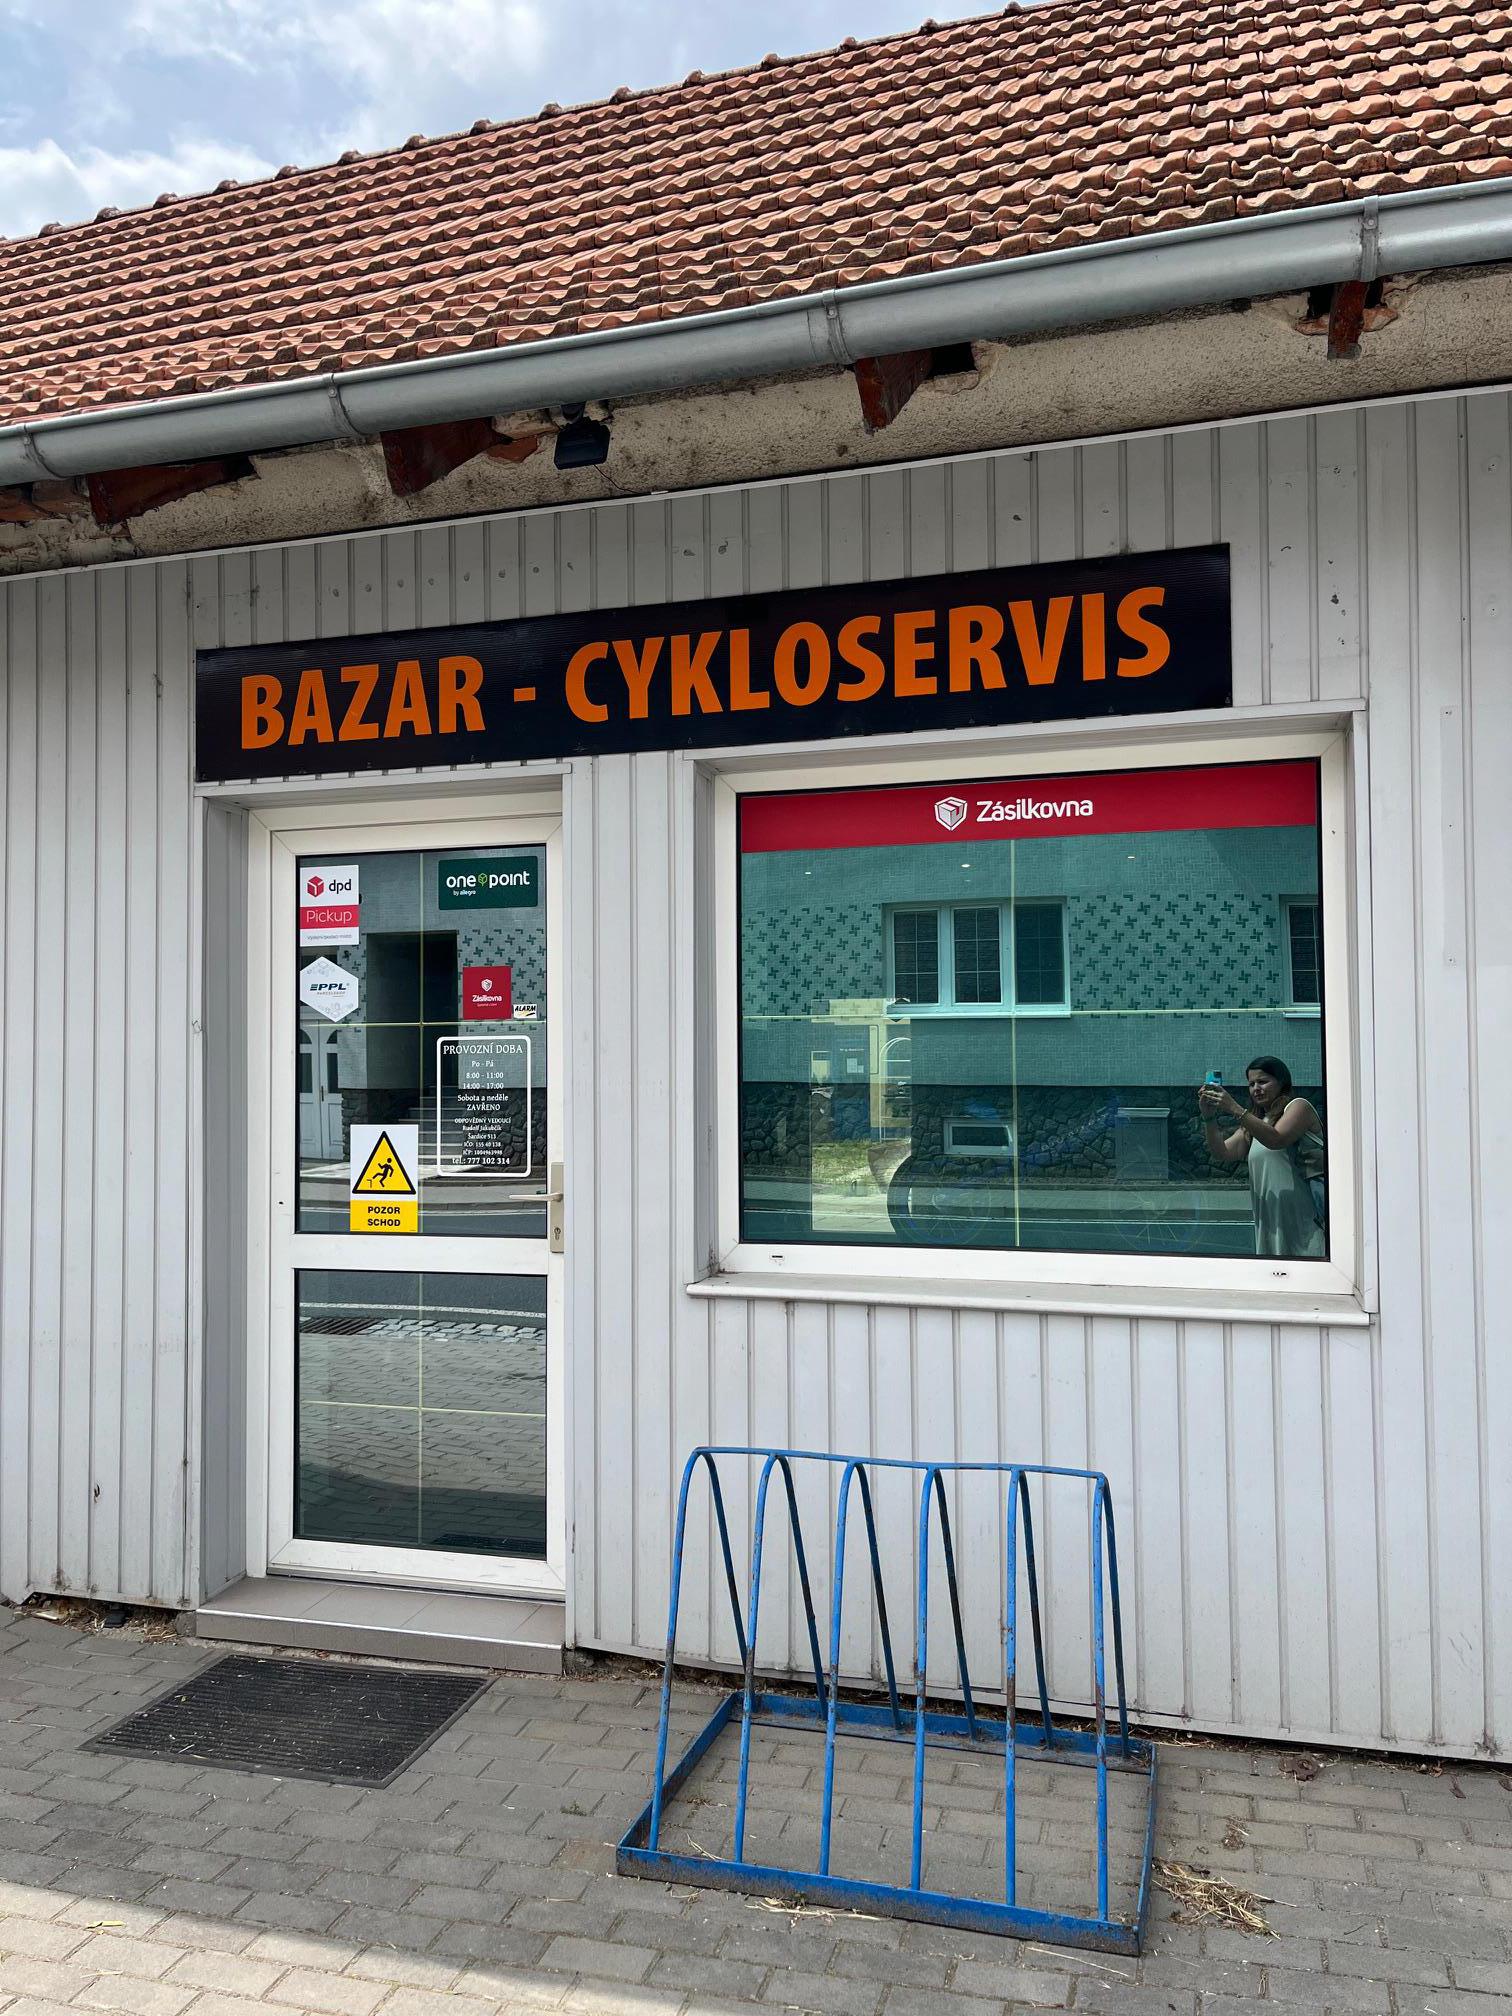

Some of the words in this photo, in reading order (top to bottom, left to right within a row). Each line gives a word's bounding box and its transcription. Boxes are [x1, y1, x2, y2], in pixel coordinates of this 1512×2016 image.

[241, 655, 486, 750] BAZAR
[513, 686, 536, 702] -
[565, 586, 1171, 723] CYKLOSERVIS
[976, 797, 1093, 822] Zásilkovna
[446, 874, 477, 888] one
[489, 870, 530, 889] point
[329, 878, 352, 894] dpd
[306, 908, 352, 925] Pickup
[318, 983, 347, 991] PPL
[443, 1043, 493, 1055] PROVOZNÍ
[496, 1044, 523, 1054] DOBA
[485, 1059, 494, 1067] Pá
[486, 1071, 504, 1079] 11:00
[457, 1093, 480, 1102] Sobota
[486, 1093, 509, 1101] neděle
[466, 1102, 501, 1111] ZAVŘENO
[482, 1157, 495, 1165] 102
[496, 1157, 510, 1165] 314
[368, 1206, 401, 1214] POZOR
[367, 1218, 401, 1227] SCHOD
